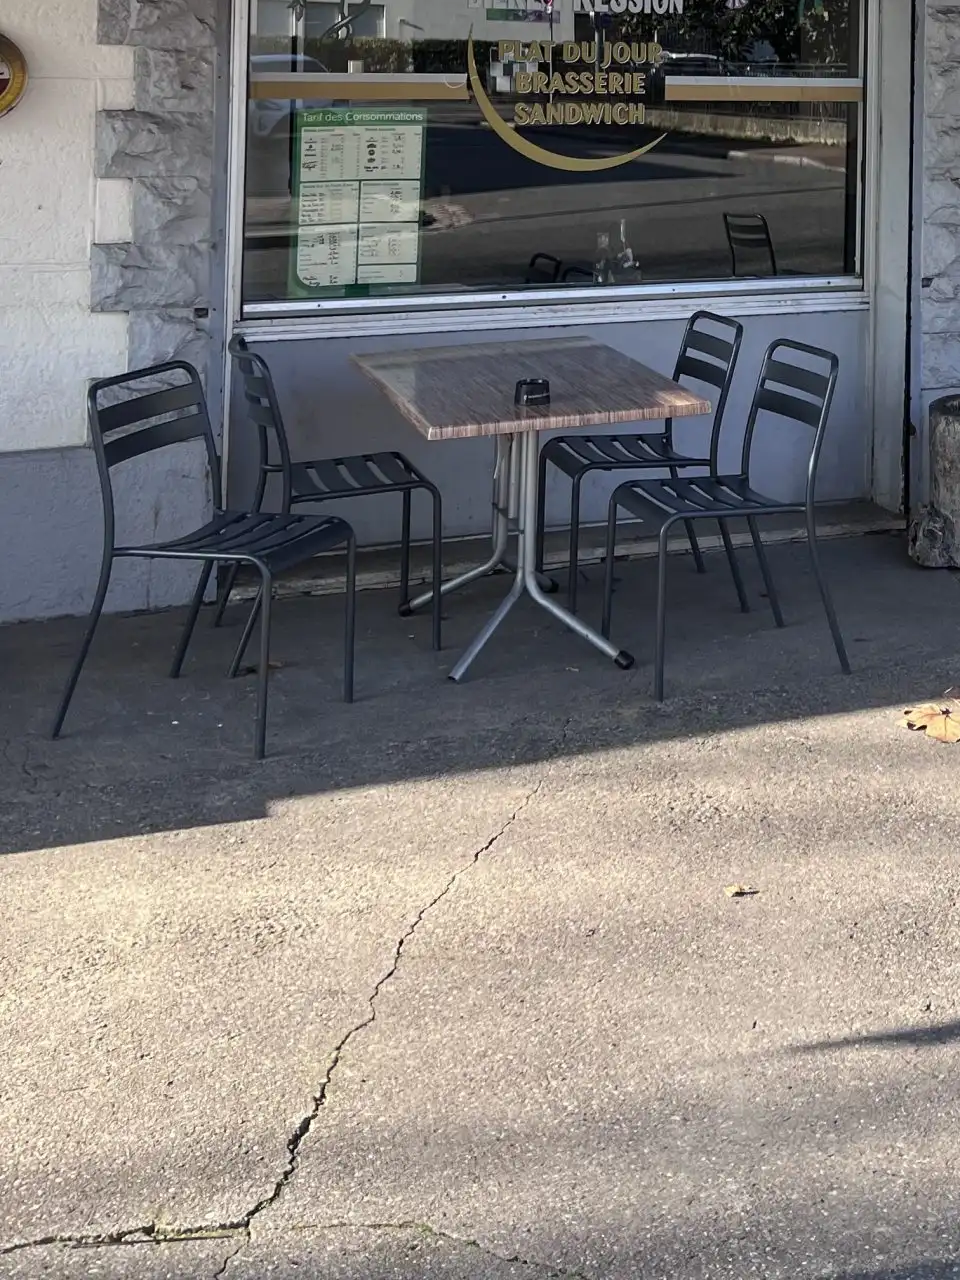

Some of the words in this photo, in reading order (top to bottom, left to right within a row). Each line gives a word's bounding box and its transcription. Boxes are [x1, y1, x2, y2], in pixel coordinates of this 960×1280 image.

[499, 40, 556, 64] PLAT
[563, 41, 597, 64] DU
[602, 41, 664, 70] JOUR
[515, 72, 647, 95] BRASSERIE
[303, 112, 323, 122] Tarif
[325, 111, 343, 121] des
[345, 111, 424, 122] Consommations
[514, 102, 646, 126] SANDWICH
